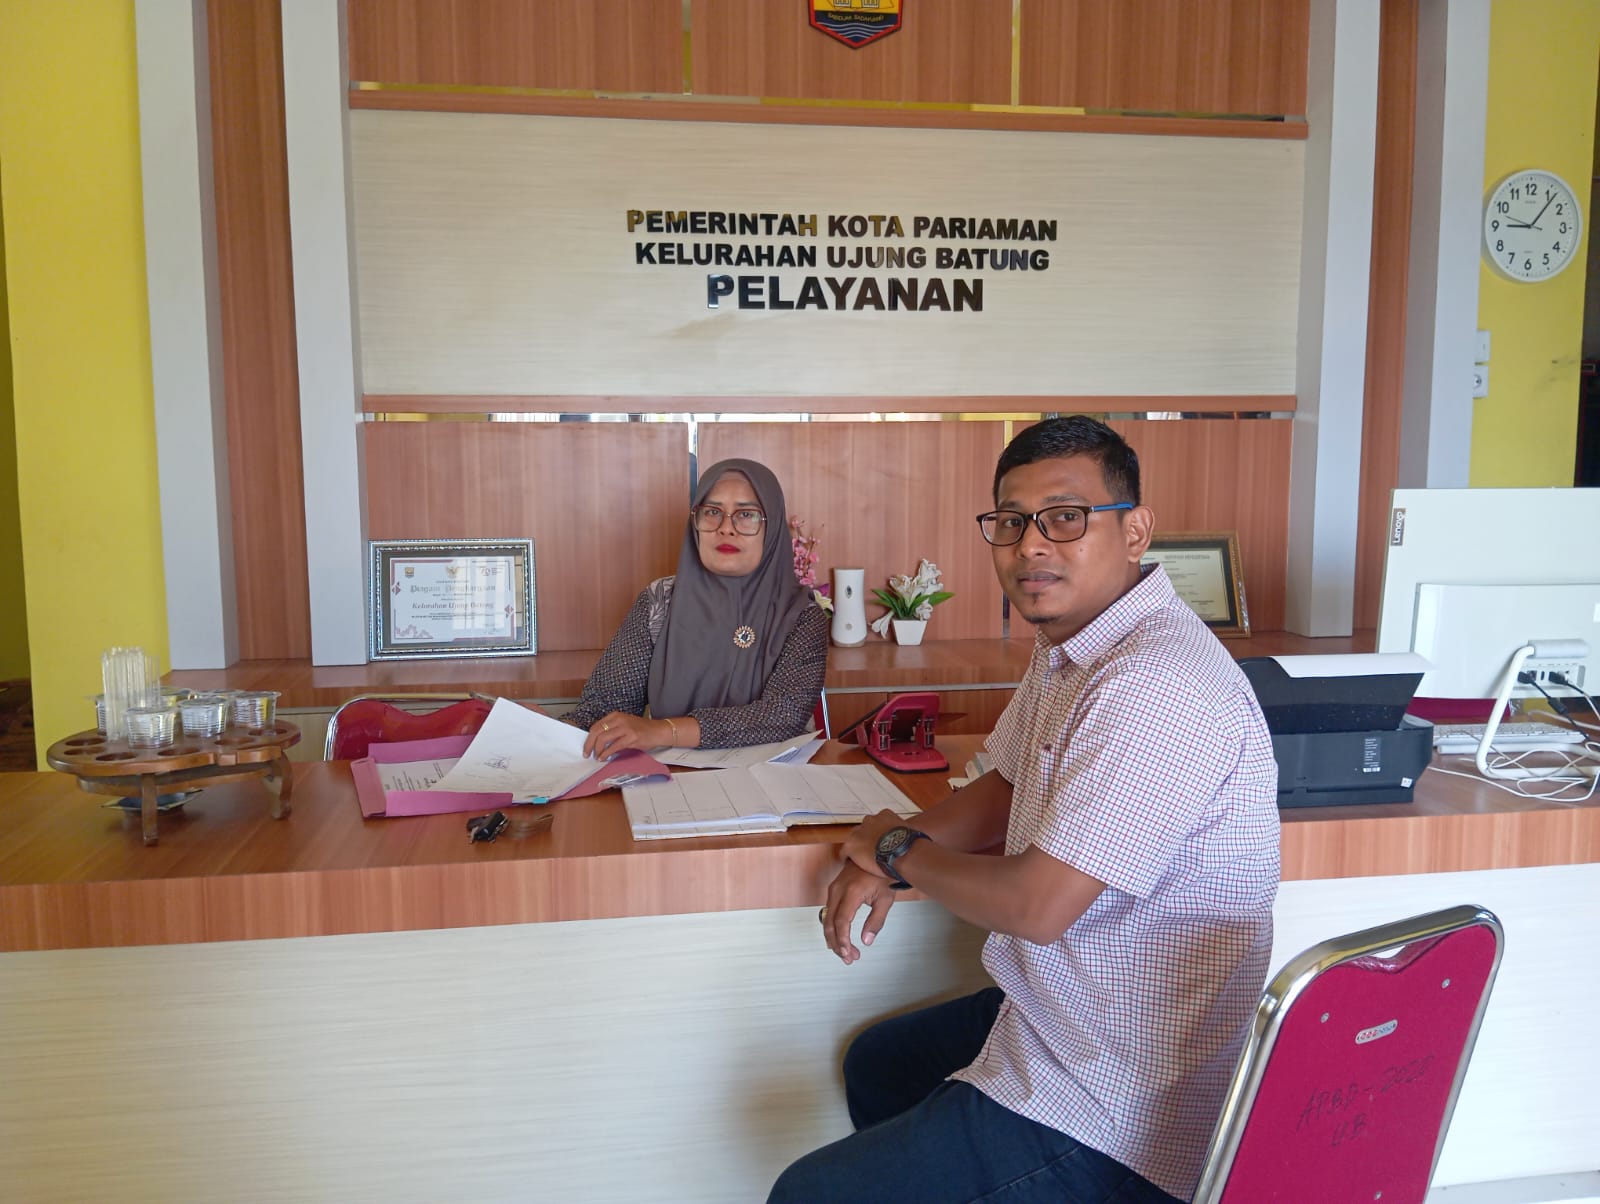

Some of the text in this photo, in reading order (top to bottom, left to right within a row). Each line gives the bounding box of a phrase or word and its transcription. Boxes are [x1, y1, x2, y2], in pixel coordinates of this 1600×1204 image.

[1510, 188, 1520, 200] 11
[1525, 183, 1537, 196] 12
[1545, 189, 1550, 201] 1
[1497, 201, 1509, 214] 10
[1555, 203, 1563, 216] 2
[626, 209, 1058, 241] PEMERINTAH KOTA PARIAMAN
[1491, 220, 1500, 232] 9
[1559, 222, 1567, 234] 3
[1496, 239, 1504, 252] 8
[1552, 241, 1561, 253] 4
[635, 242, 1050, 271] KELURAHAN UJUNG BATUNG
[1508, 252, 1515, 264] 7
[1542, 253, 1550, 265] 5
[1524, 258, 1532, 270] 6
[706, 273, 984, 312] PELAYANAN
[1392, 511, 1404, 543] Lenovo
